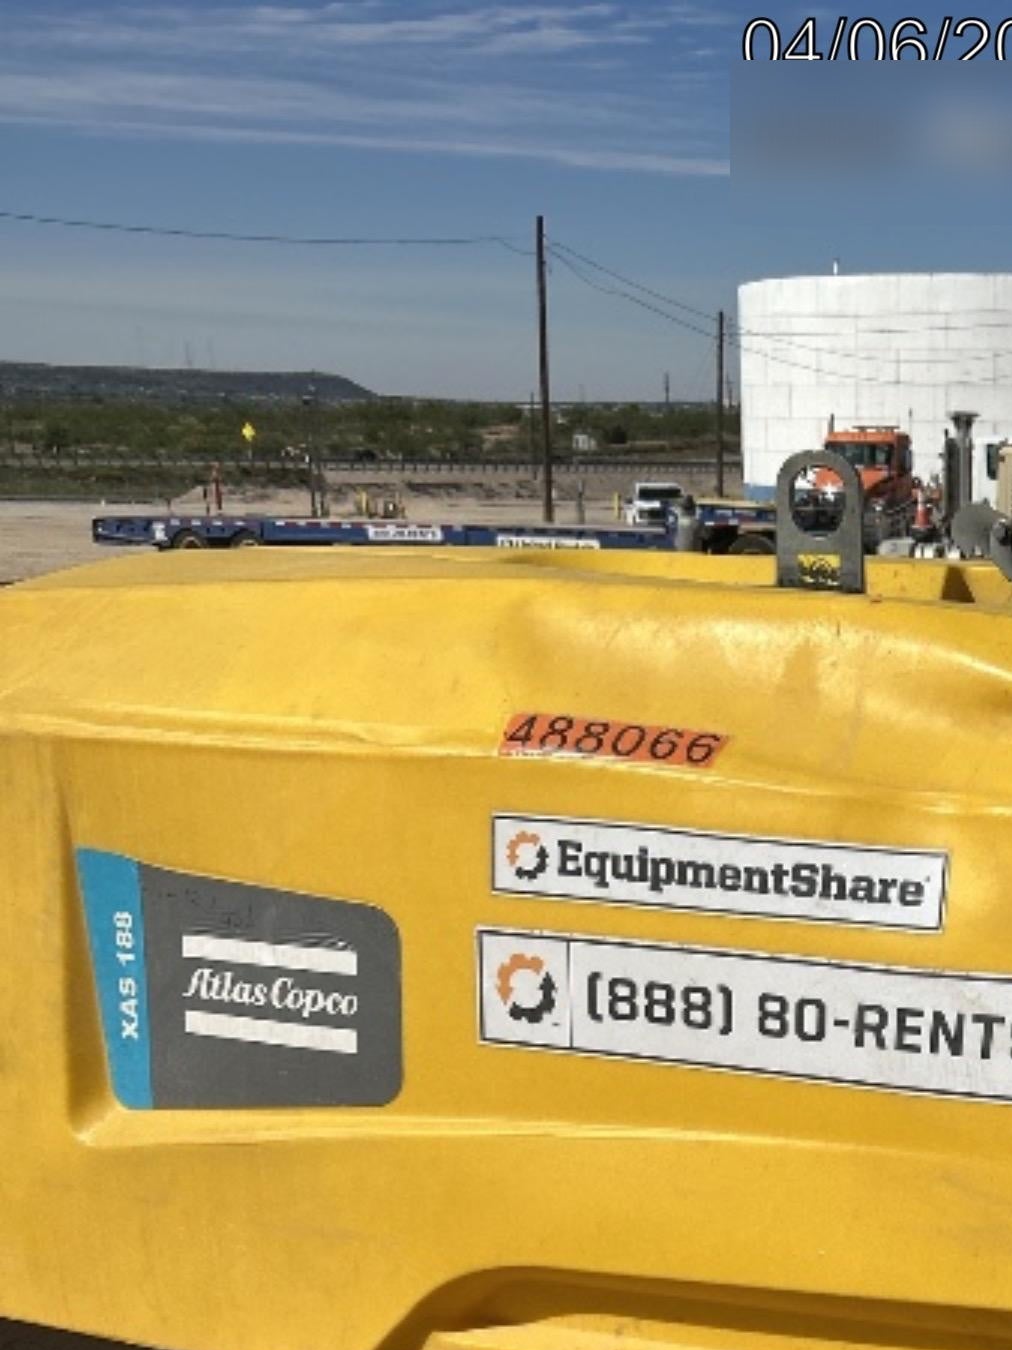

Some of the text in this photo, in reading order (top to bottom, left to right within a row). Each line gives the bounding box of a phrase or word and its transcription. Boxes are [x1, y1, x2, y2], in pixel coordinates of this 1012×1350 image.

[504, 714, 721, 764] 488066
[557, 839, 926, 907] EquipmentShare
[119, 978, 138, 1041] XAS
[182, 967, 358, 1018] Atlas Copco
[586, 971, 735, 1036] (888)
